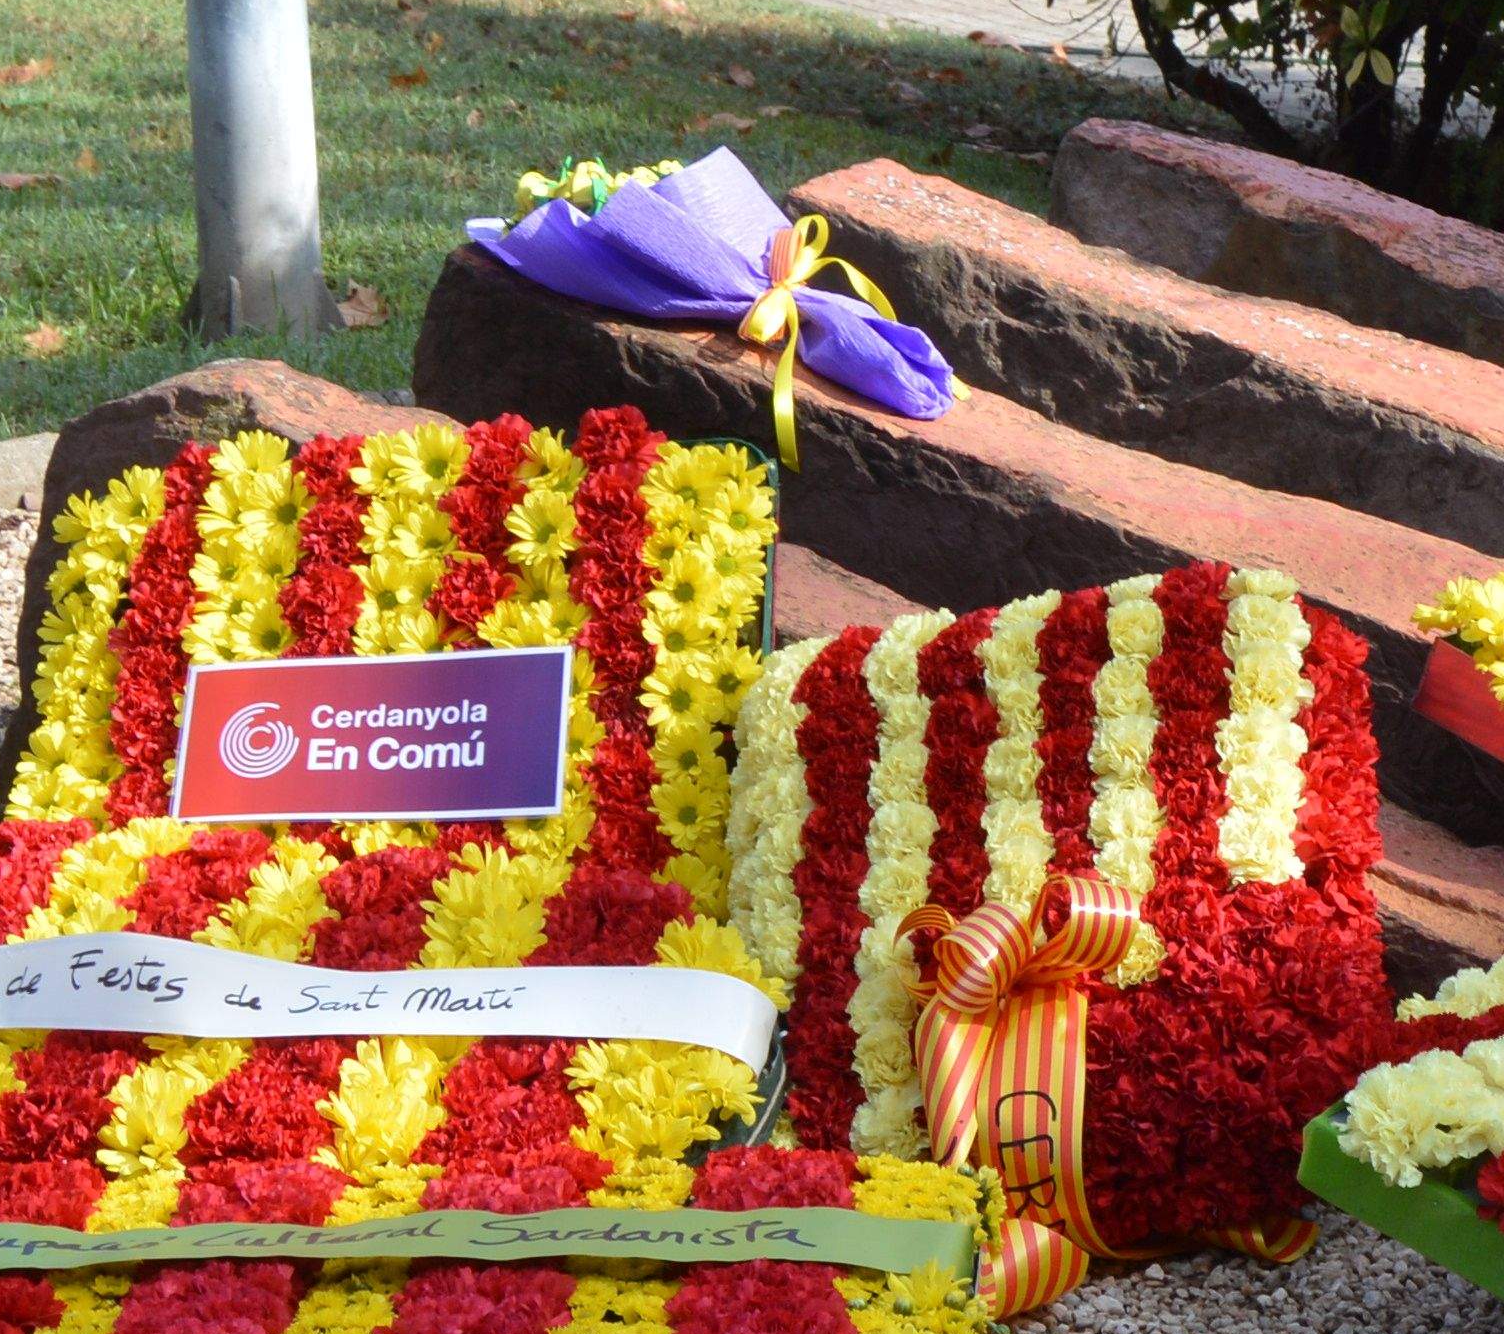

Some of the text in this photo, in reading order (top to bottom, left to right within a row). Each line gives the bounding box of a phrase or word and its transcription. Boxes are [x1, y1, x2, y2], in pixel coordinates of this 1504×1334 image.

[310, 699, 488, 731] Cerdanyola
[306, 729, 486, 771] En Comú
[4, 966, 43, 997] de
[68, 948, 189, 1003] Festes
[224, 983, 263, 1011] de
[287, 983, 388, 1014] Sant
[995, 1090, 1066, 1233] CER
[192, 1217, 445, 1248] Cultural
[468, 1216, 818, 1249] Sardanista
